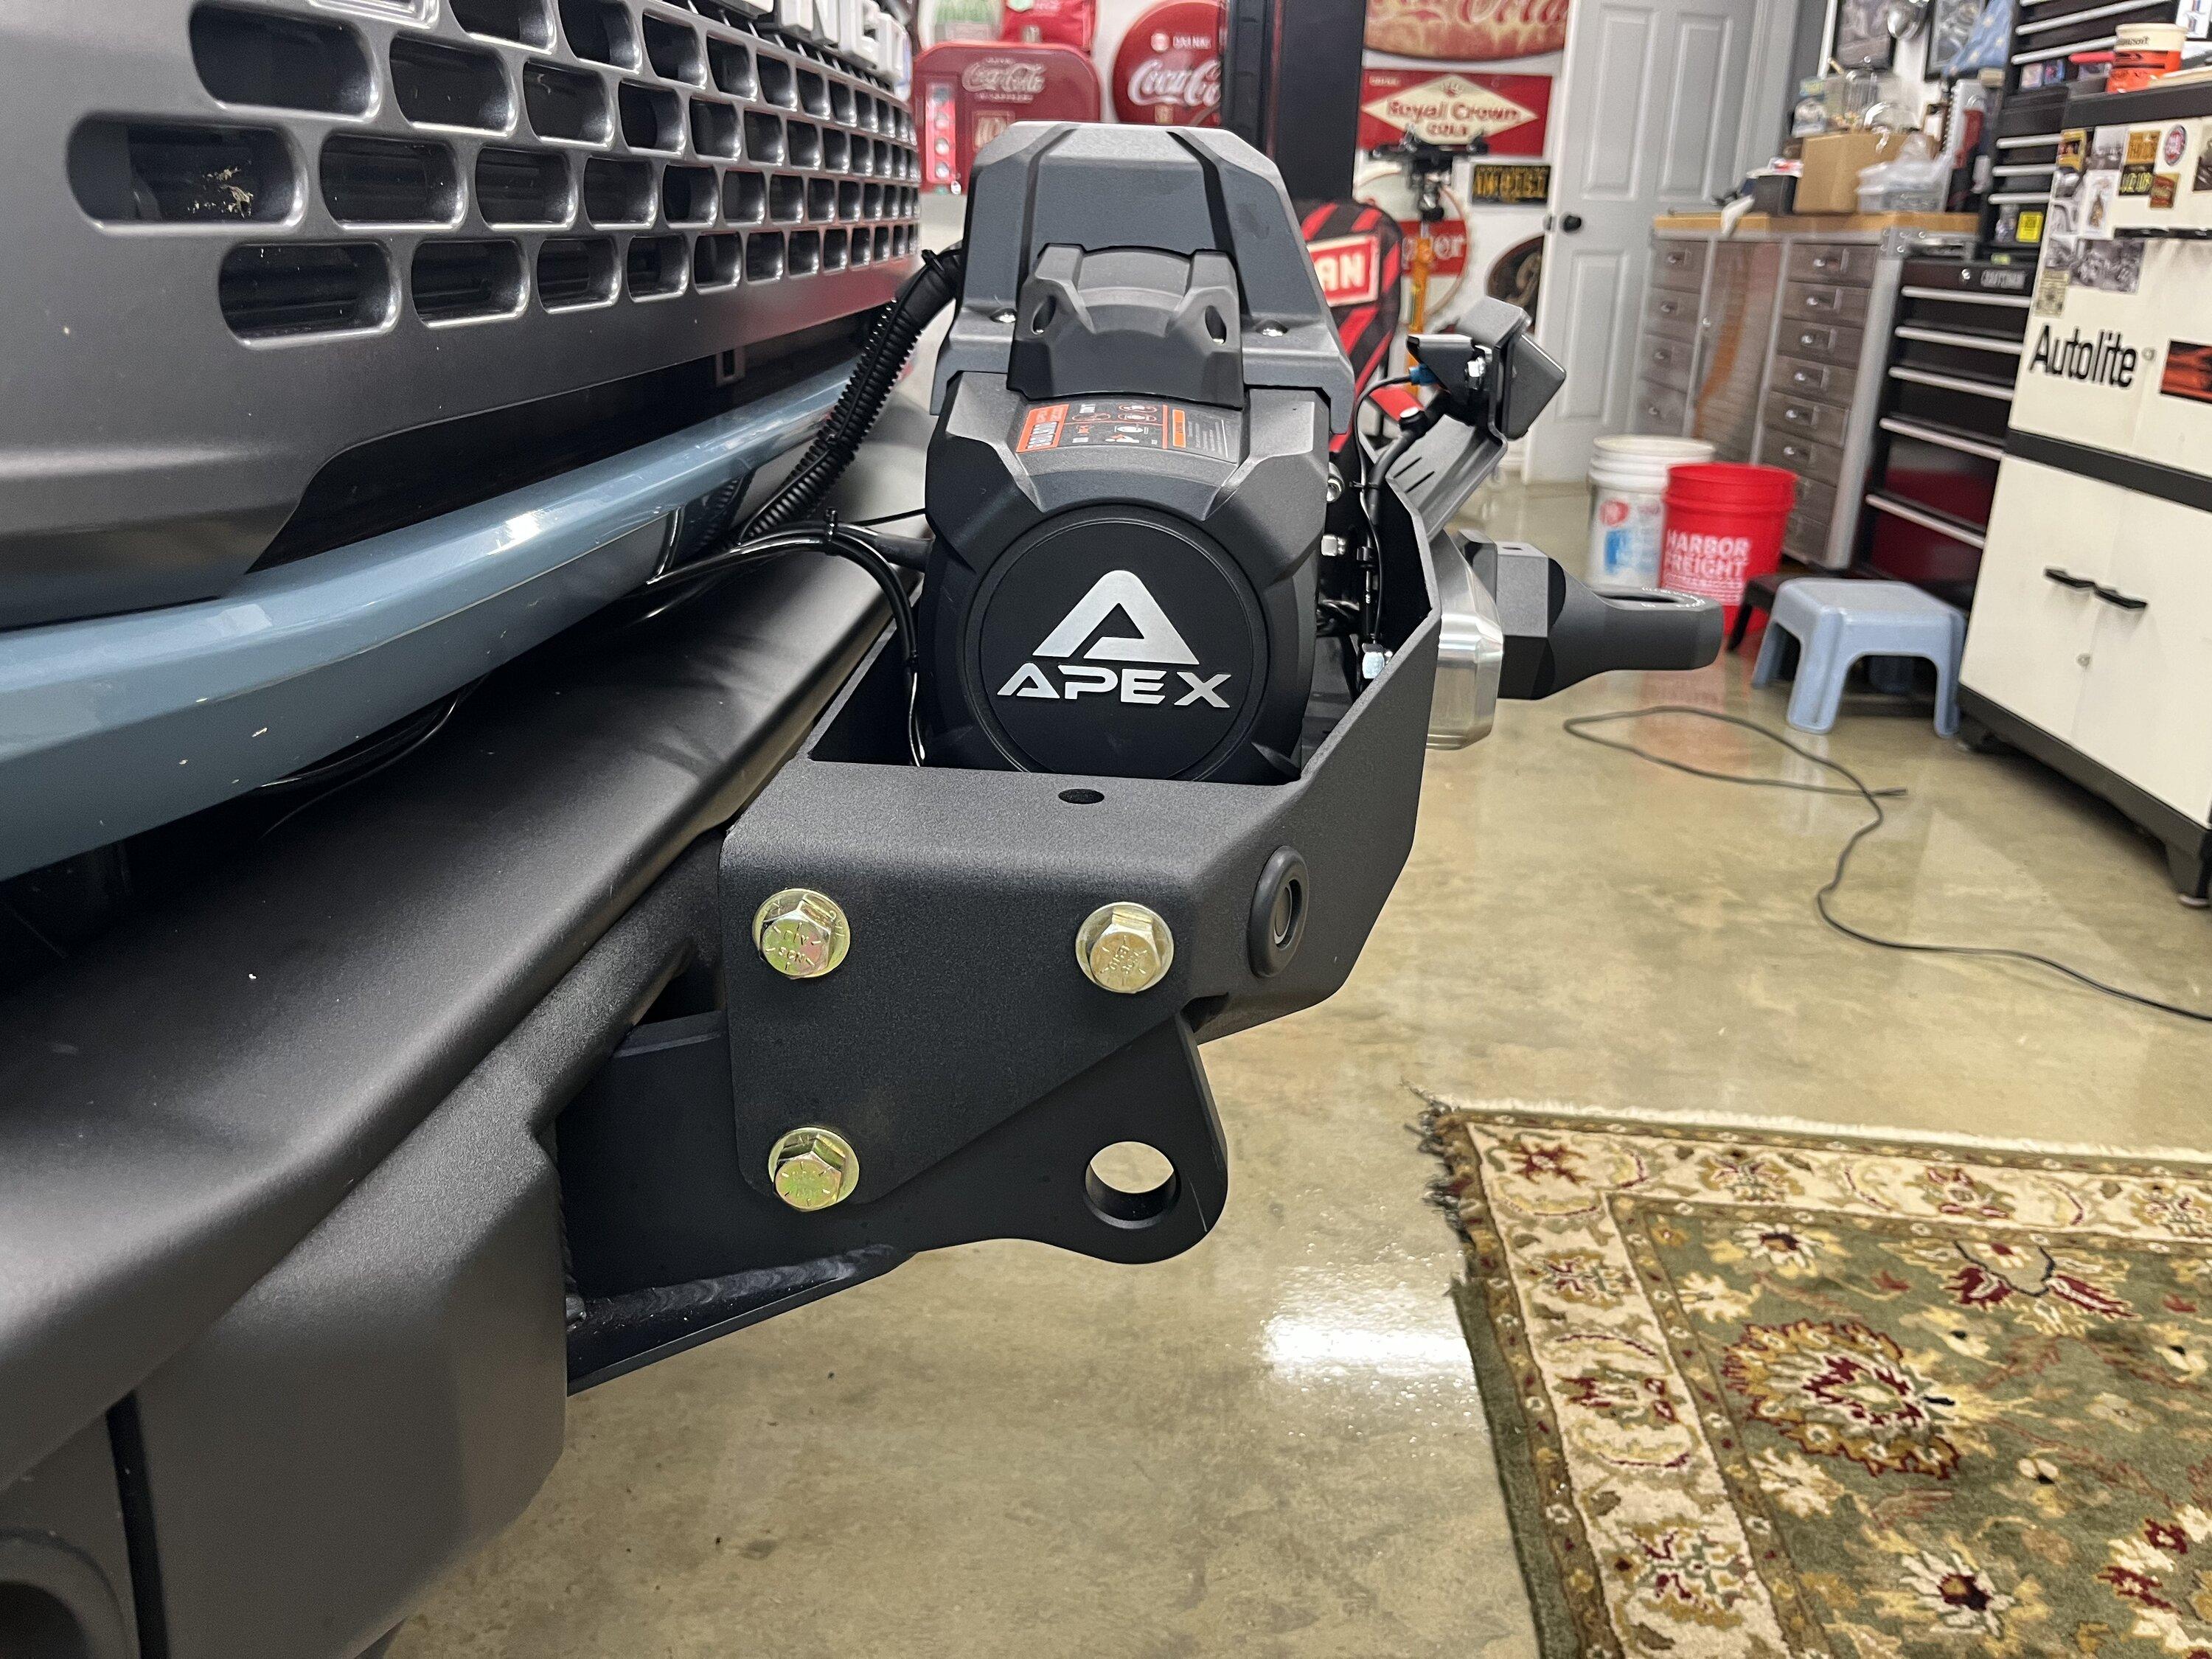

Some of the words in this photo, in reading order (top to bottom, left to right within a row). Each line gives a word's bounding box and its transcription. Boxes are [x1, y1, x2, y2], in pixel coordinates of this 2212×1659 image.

[1388, 101, 1447, 123] Royal
[1451, 102, 1521, 121] Crown
[2028, 324, 2137, 388] Autolite
[1666, 529, 1750, 558] HARBOR
[1664, 551, 1749, 580] FREIGHT
[997, 662, 1231, 709] APEX
